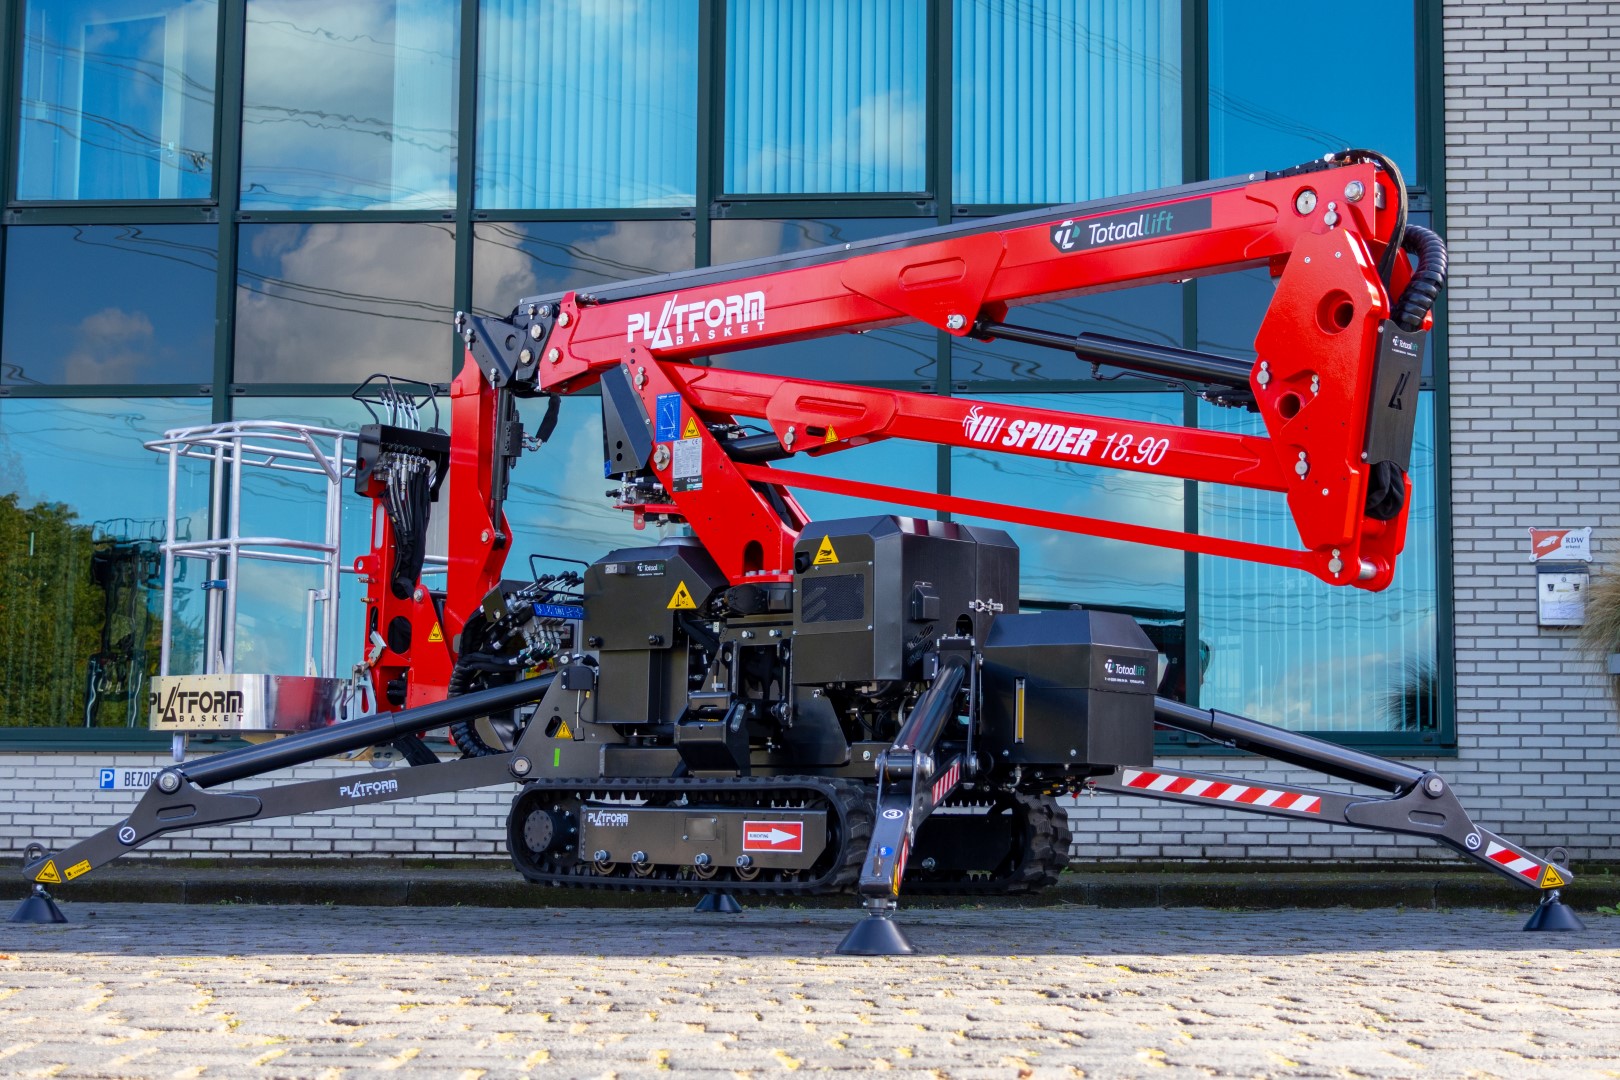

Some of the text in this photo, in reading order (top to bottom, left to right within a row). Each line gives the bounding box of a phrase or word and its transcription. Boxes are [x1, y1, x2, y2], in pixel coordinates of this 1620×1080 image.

[1088, 210, 1174, 245] Totaallift
[627, 291, 765, 349] PLATFORM
[676, 321, 765, 345] BASKET
[1002, 419, 1170, 466] SPIDER 18.90
[149, 682, 244, 722] PLATFORM
[179, 714, 244, 723] BASKET
[101, 770, 159, 787] P BEZOE
[339, 779, 398, 798] PLATFORM
[587, 809, 629, 827] PLATFORM
